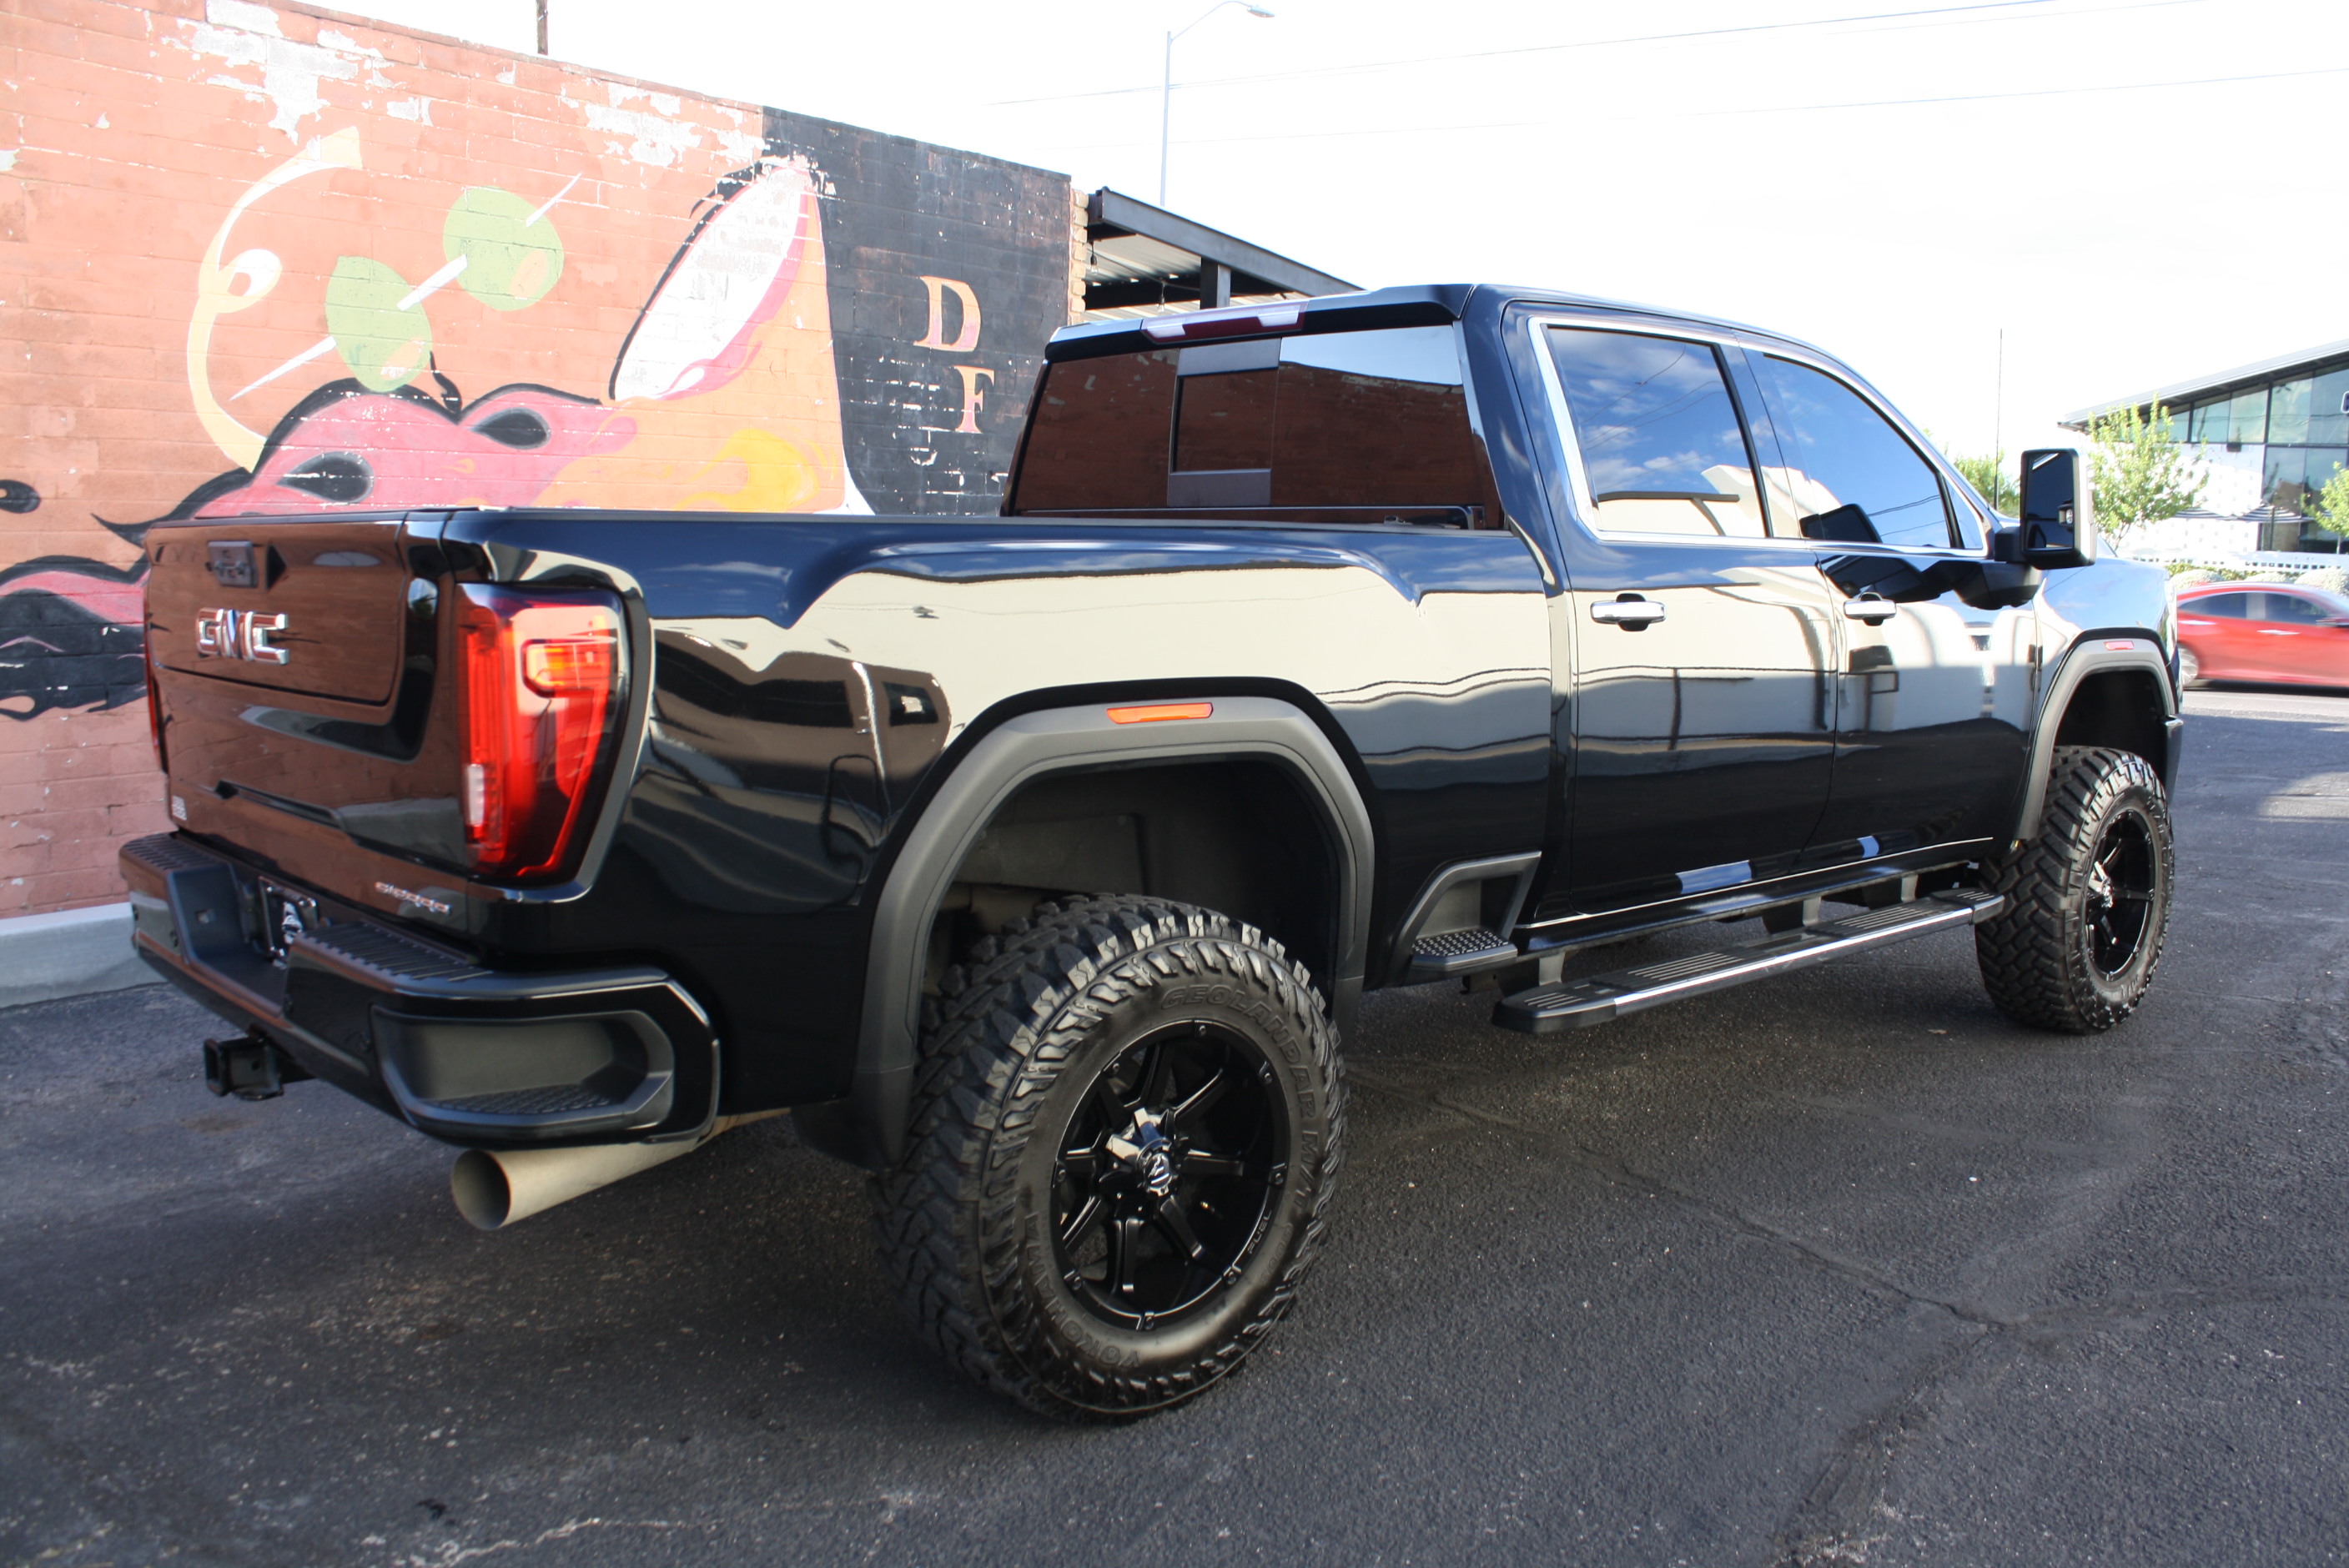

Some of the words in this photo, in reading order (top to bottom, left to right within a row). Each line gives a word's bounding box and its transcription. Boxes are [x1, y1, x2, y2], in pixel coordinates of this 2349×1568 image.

[913, 275, 981, 352] D
[955, 365, 995, 434] F
[197, 607, 289, 665] GMC
[1160, 983, 1317, 1118] GEOLANDAR
[1247, 1209, 1273, 1254] FUEL
[1024, 1212, 1139, 1367] YOKOHAMA
